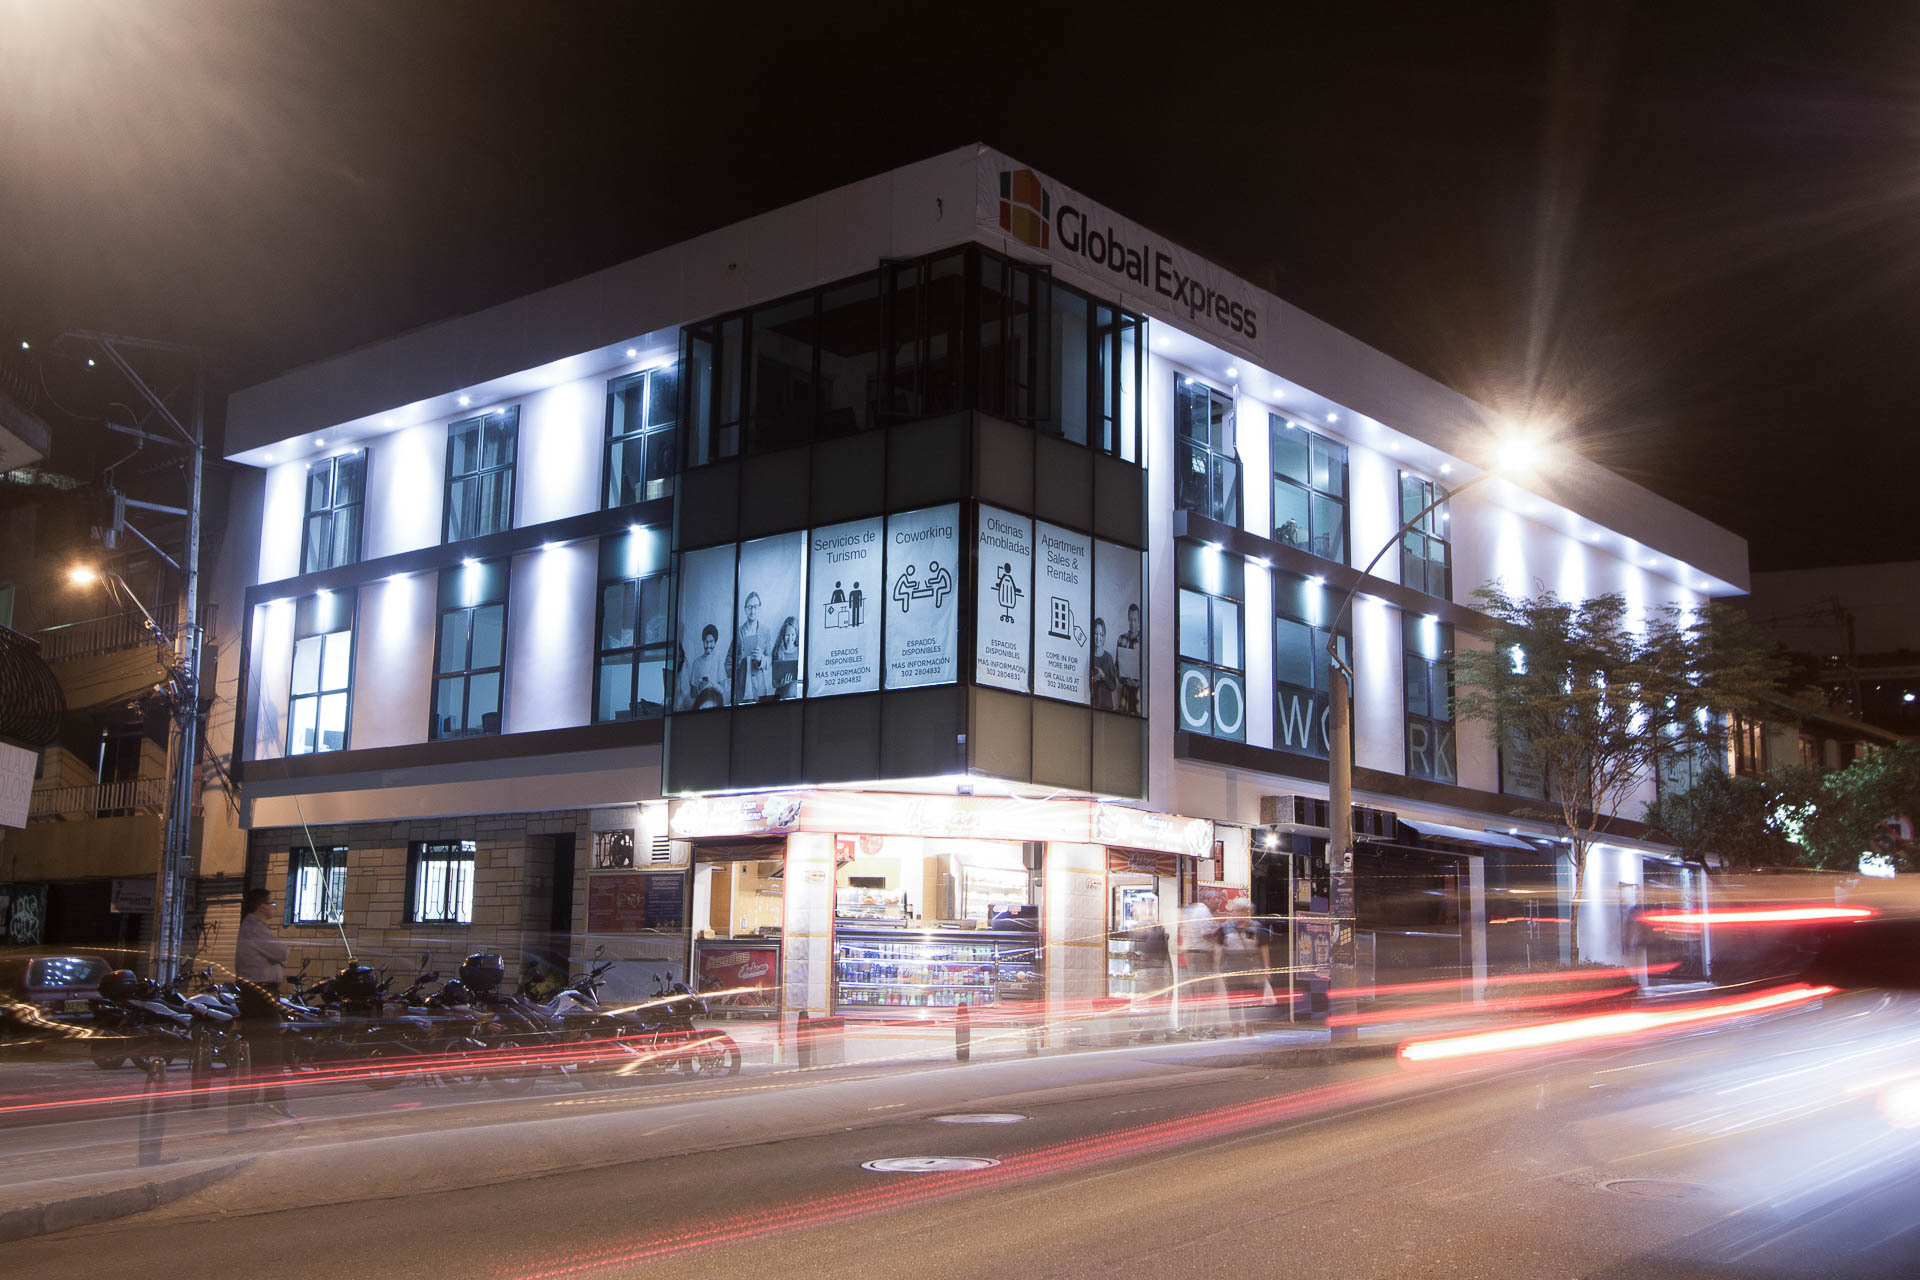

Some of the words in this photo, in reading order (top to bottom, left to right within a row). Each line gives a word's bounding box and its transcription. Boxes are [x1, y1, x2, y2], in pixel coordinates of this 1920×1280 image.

[1056, 204, 1150, 287] Global
[1154, 251, 1258, 340] Express
[895, 525, 953, 545] Coworking
[987, 518, 1024, 539] Oficinas
[814, 535, 860, 551] Servicios
[862, 530, 876, 544] de
[979, 531, 1030, 556] Amobladas
[1041, 534, 1085, 557] Apartment
[826, 548, 867, 564] Turismo
[1047, 550, 1071, 568] Sales
[1071, 557, 1079, 570] &
[1046, 565, 1079, 585] Rentals
[907, 637, 936, 647] ESPACIOS
[991, 639, 1017, 651] ESPACIOS
[830, 647, 859, 657] ESPACIOS
[901, 645, 941, 656] DISPONIBLES
[985, 647, 1020, 660] DISPONIBLES
[1045, 651, 1061, 661] COME
[1060, 654, 1067, 662] IN
[1067, 655, 1078, 664] FOR
[825, 655, 863, 666] DISPONIBLES
[1048, 660, 1063, 670] MORE
[1064, 662, 1076, 672] INFO
[901, 669, 912, 677] 302
[914, 666, 941, 676] 2804832
[986, 667, 996, 676] 302
[997, 669, 1020, 681] 2804832
[1043, 671, 1052, 679] OR
[1052, 673, 1066, 682] CALL
[1066, 675, 1074, 683] US
[1074, 677, 1080, 685] AT
[824, 678, 836, 686] 302
[837, 675, 862, 685] 2804832
[1047, 679, 1056, 688] 302
[1057, 681, 1078, 693] 2804832
